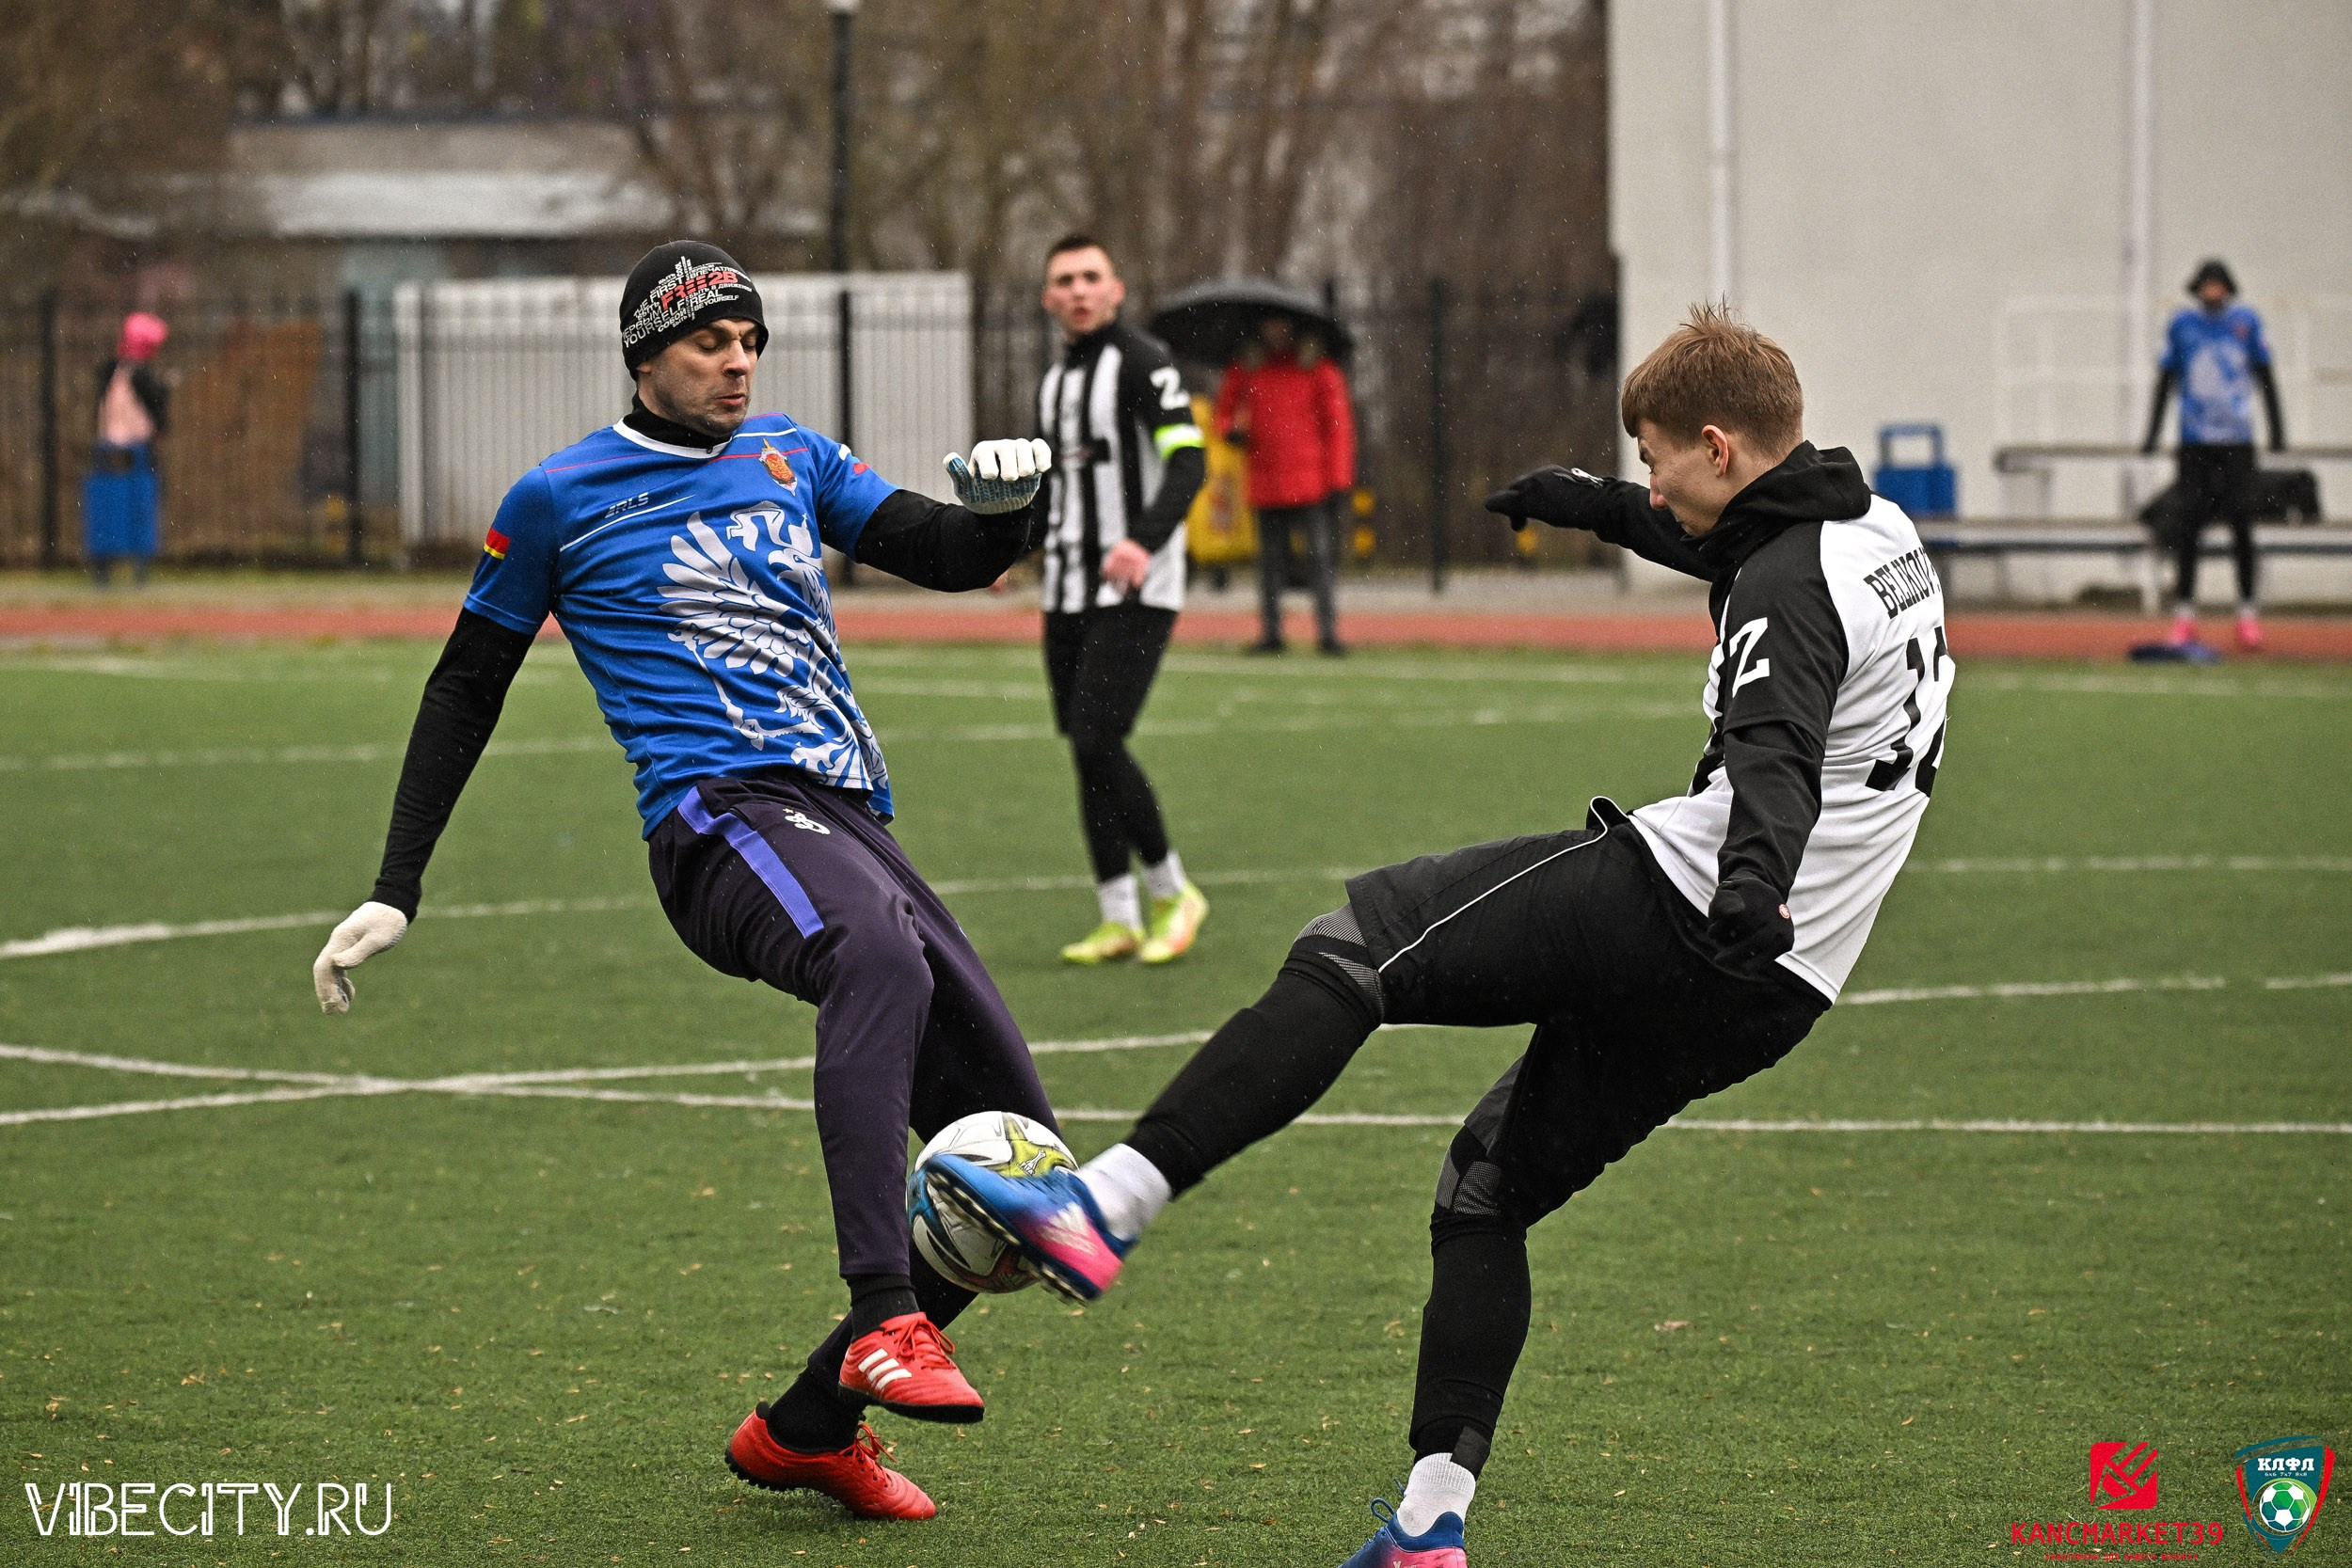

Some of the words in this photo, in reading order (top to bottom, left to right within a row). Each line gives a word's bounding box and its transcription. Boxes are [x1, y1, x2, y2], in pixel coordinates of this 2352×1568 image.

[633, 298, 649, 318] THE
[649, 275, 685, 304] FIRST
[690, 289, 723, 308] REAL
[624, 298, 685, 348] YOURSELF
[658, 308, 687, 332] СОБОЙ
